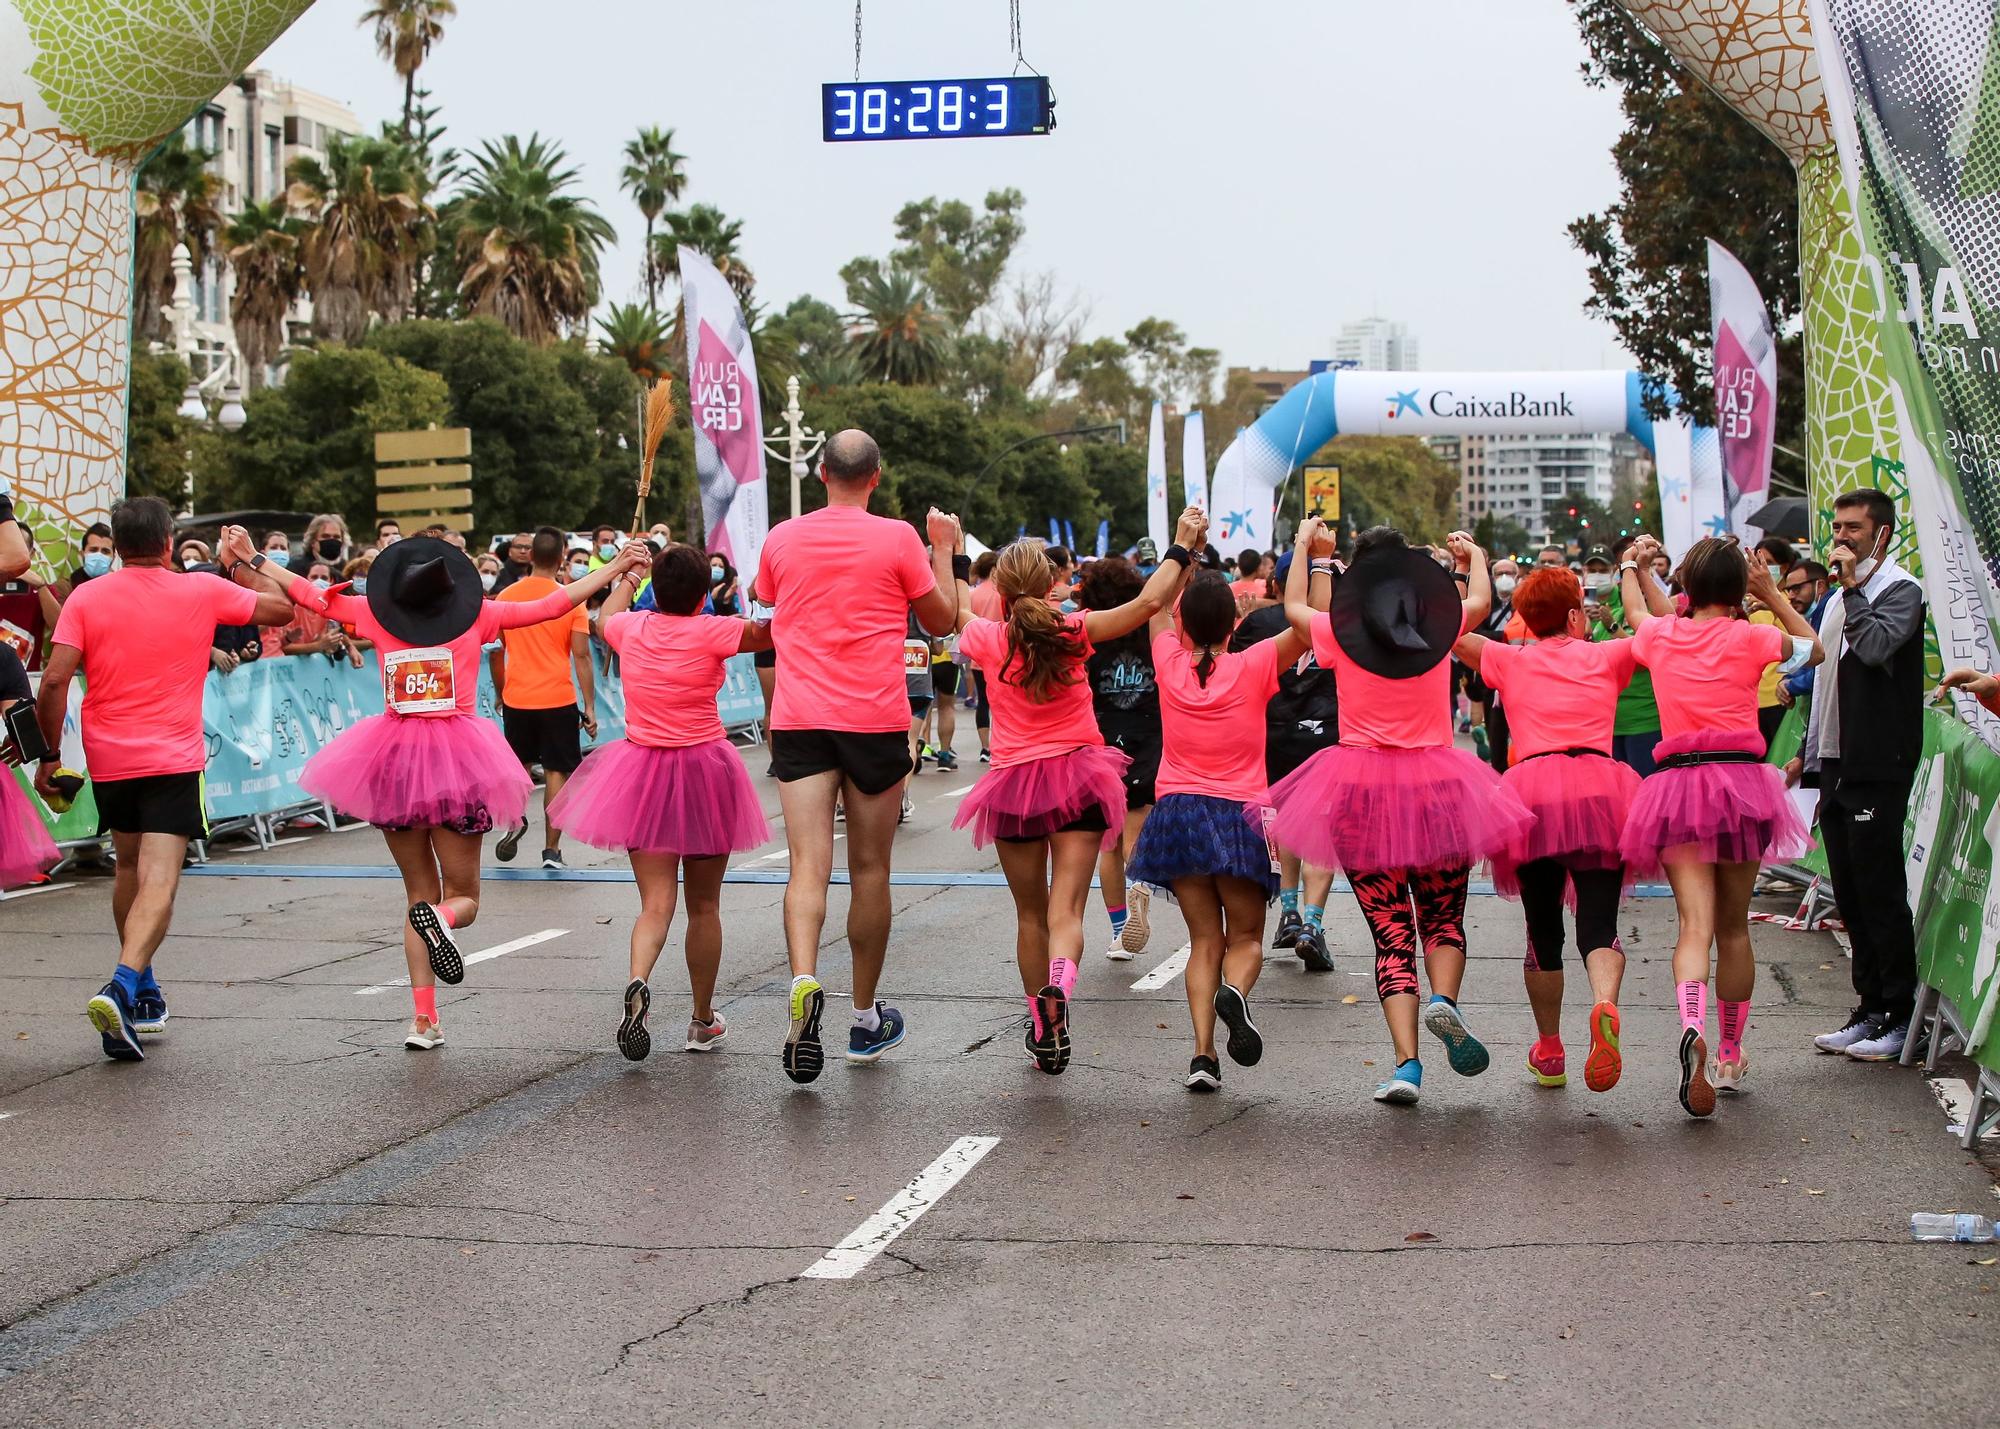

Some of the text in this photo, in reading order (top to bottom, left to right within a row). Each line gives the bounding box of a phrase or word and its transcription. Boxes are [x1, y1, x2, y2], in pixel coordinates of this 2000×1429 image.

[834, 84, 1008, 135] 38:28:3
[1429, 390, 1575, 418] CaixaBank
[903, 652, 924, 664] 845
[405, 672, 439, 695] 654
[1113, 663, 1143, 689] Ado
